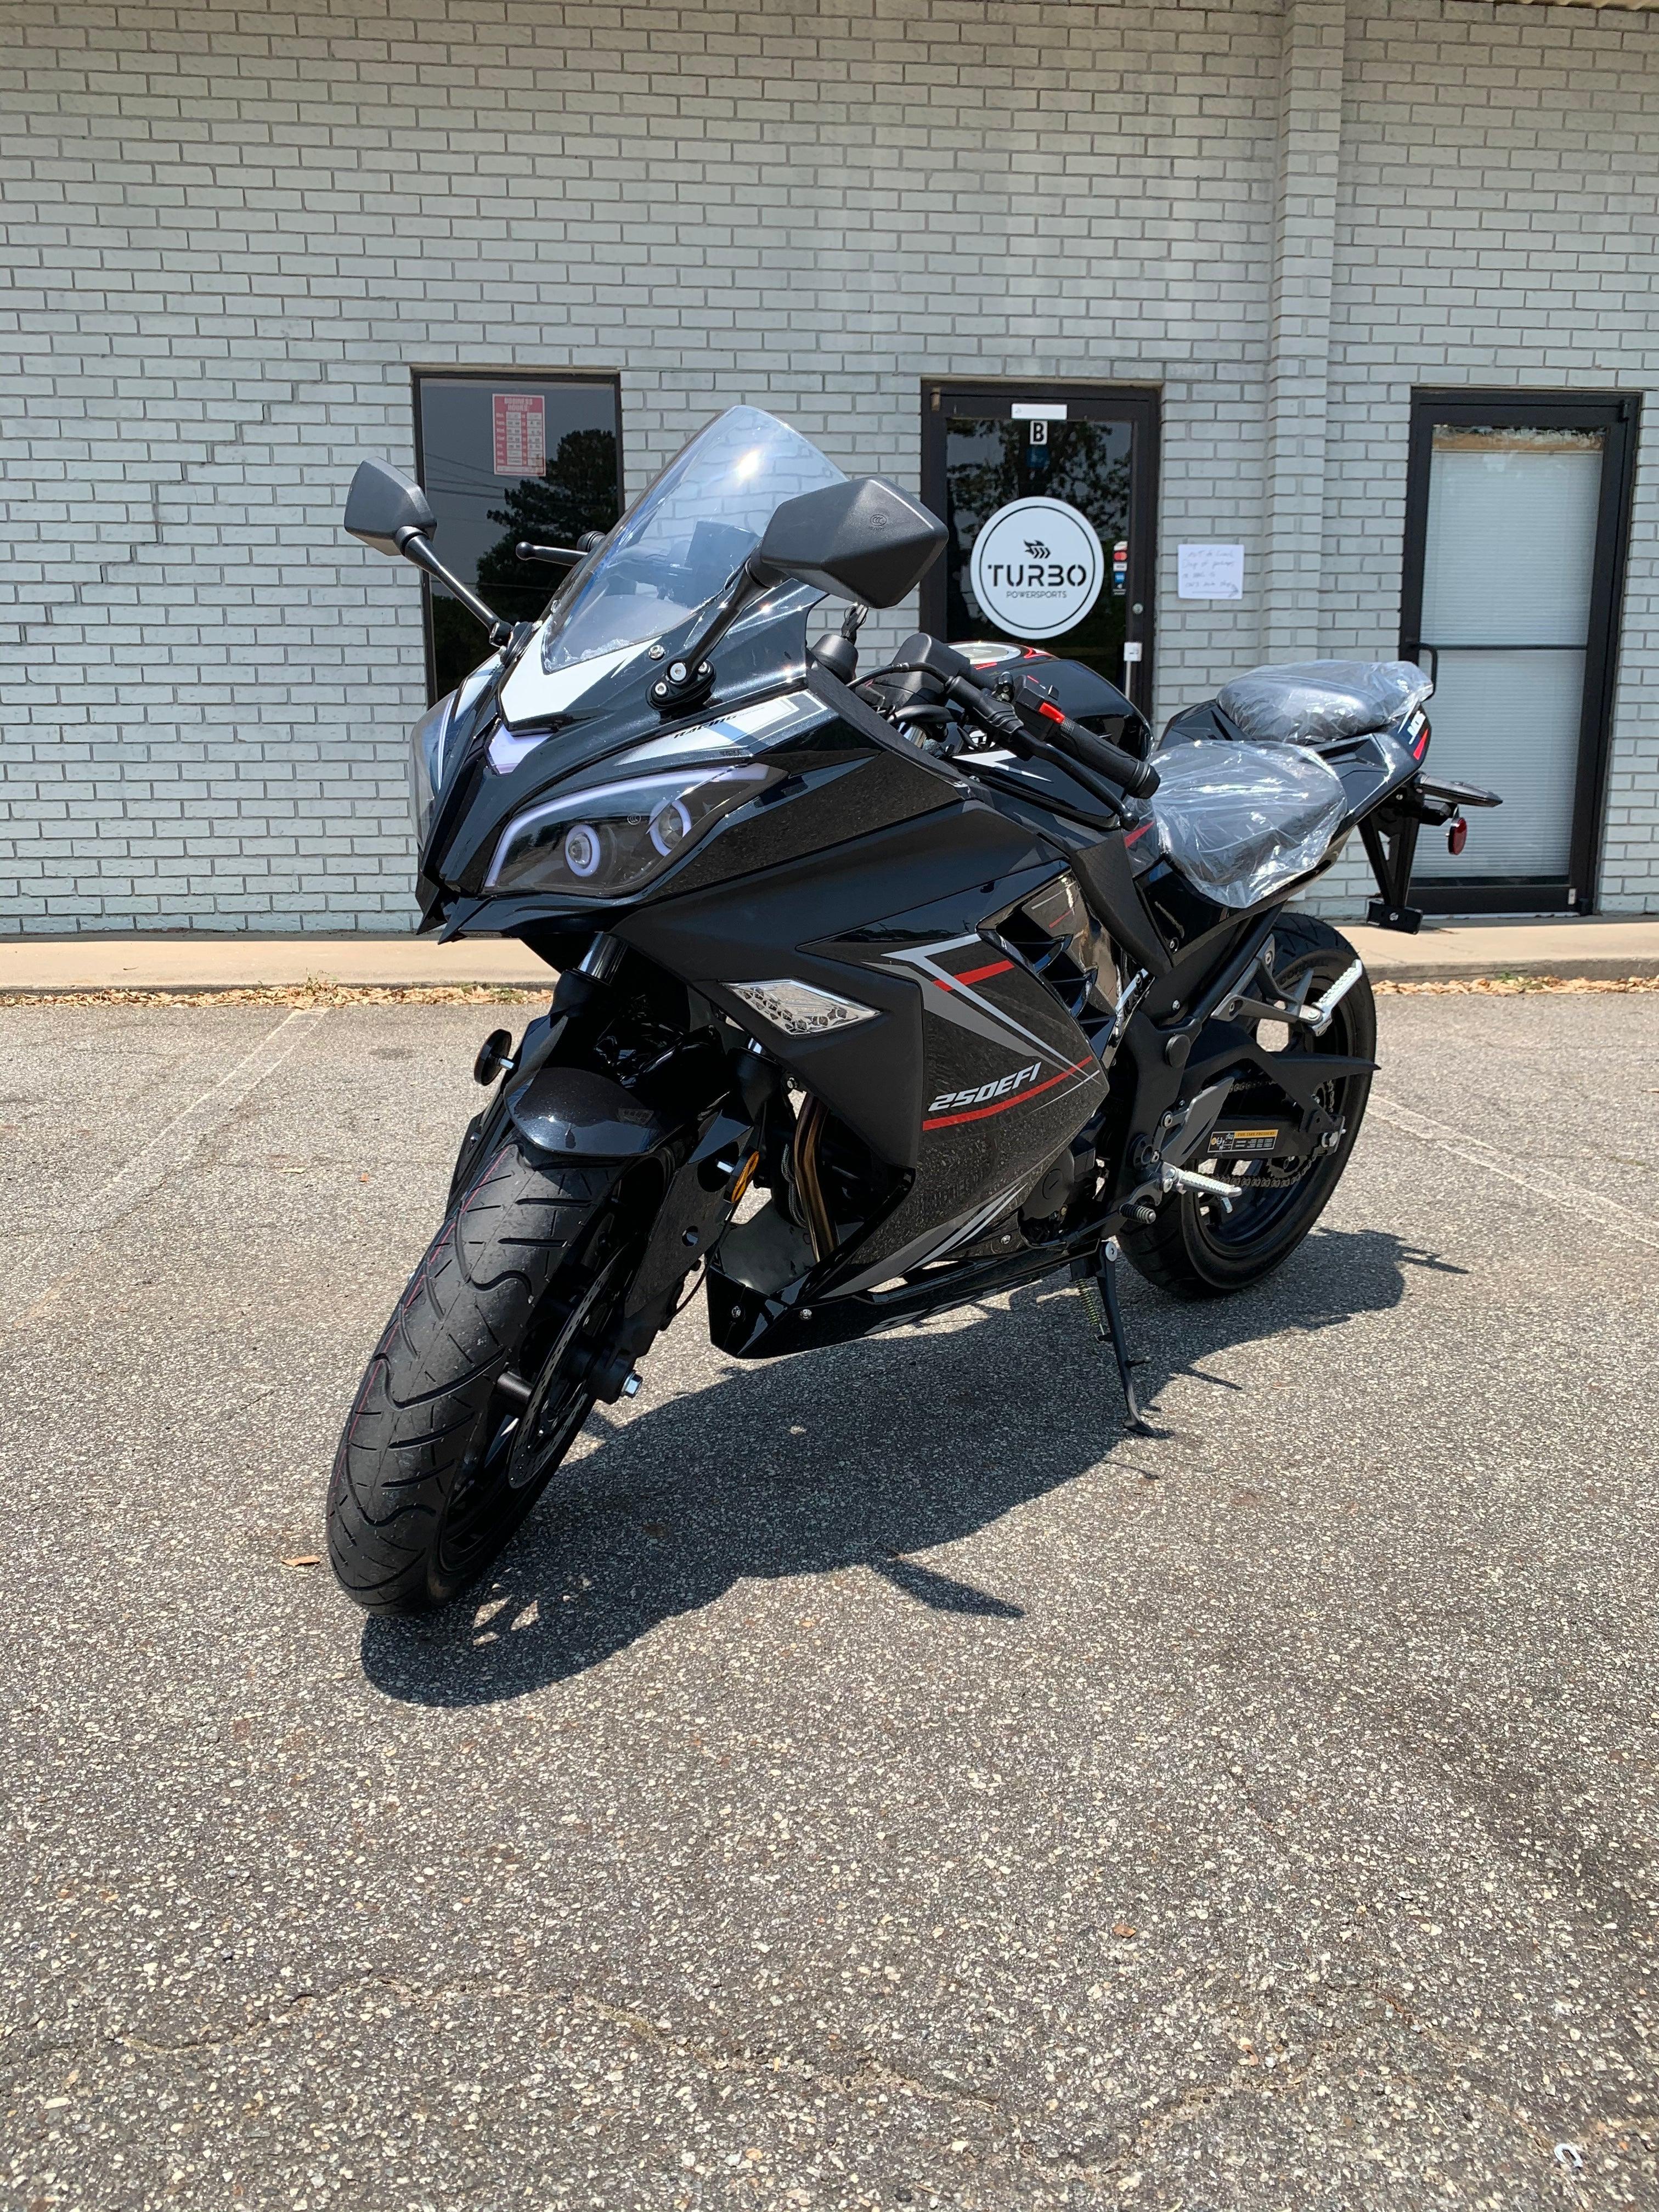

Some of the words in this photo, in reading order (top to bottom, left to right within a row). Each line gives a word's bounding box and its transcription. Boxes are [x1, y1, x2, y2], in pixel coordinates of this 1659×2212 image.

[1033, 422, 1044, 442] B
[988, 564, 1086, 587] TURBO
[1006, 590, 1068, 599] POWERSPORTS
[927, 1062, 1042, 1112] 250EFI
